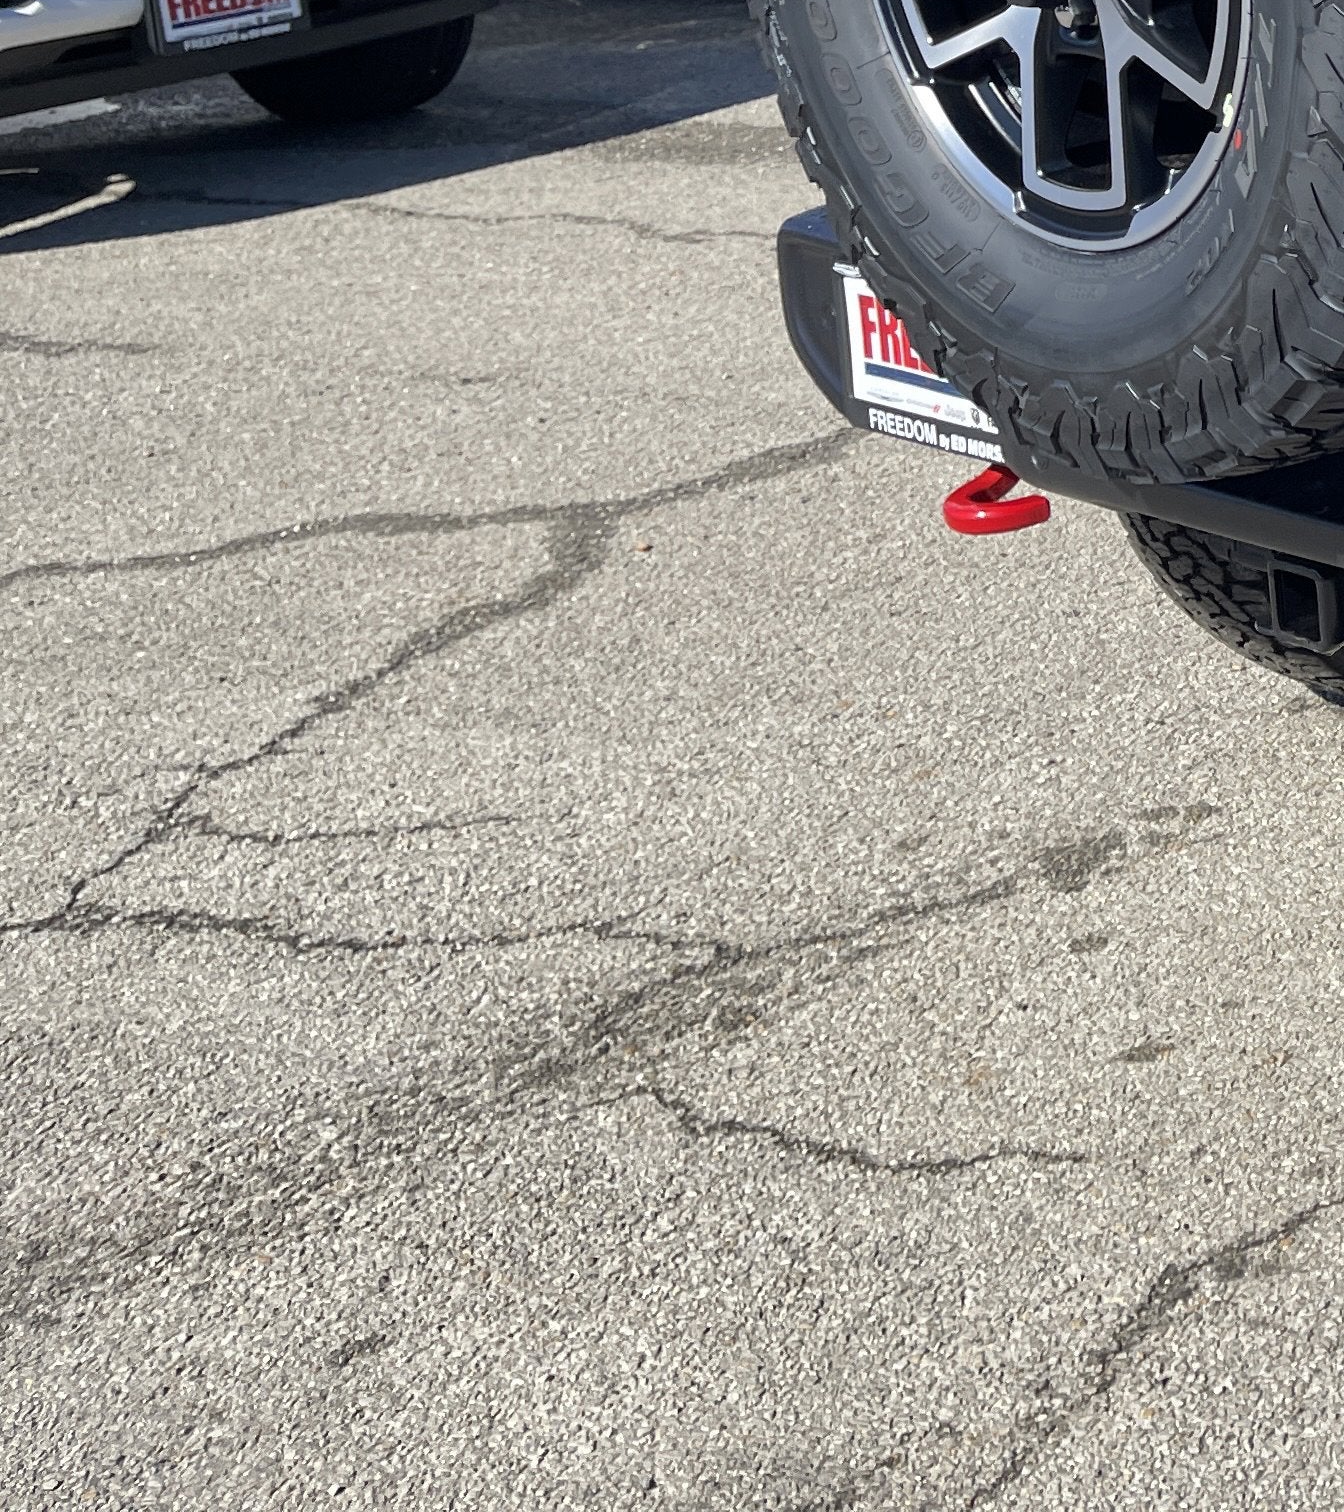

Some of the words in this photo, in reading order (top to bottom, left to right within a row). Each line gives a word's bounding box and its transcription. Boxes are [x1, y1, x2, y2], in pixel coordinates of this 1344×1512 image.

[868, 407, 938, 446] FREEDOM
[950, 433, 967, 453] ED
[967, 438, 1006, 464] MORS
